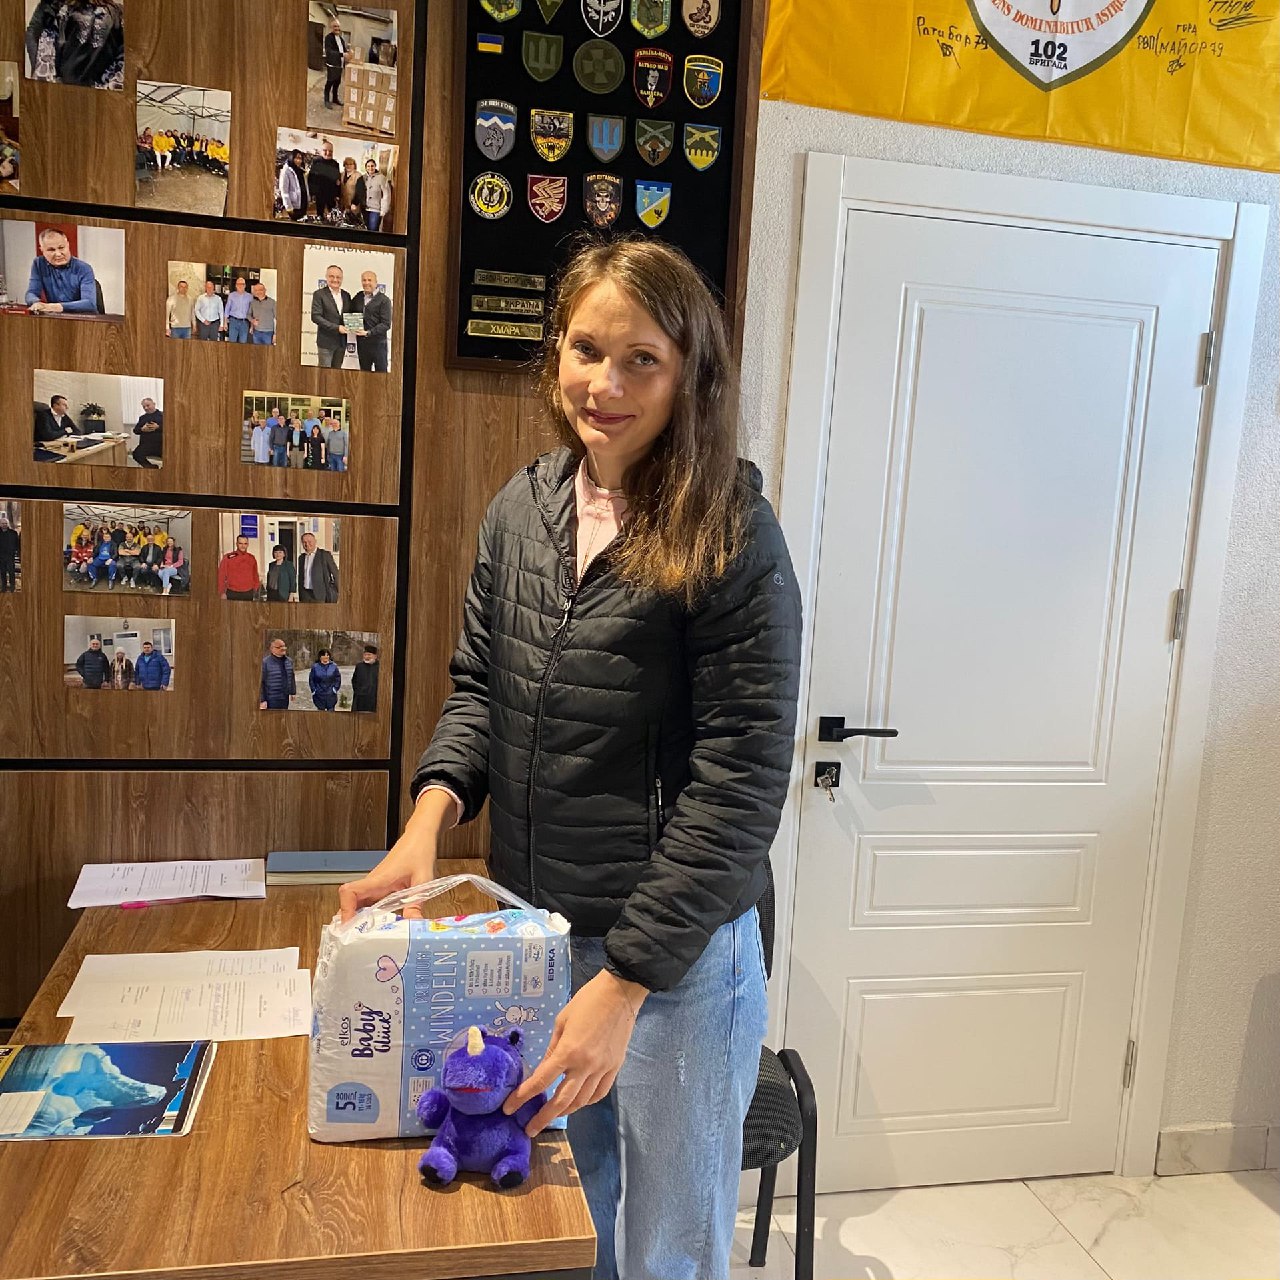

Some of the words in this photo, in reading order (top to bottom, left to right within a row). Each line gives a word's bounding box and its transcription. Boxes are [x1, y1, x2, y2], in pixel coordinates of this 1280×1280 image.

[1028, 57, 1068, 70] БРИГАДА
[1029, 39, 1068, 63] 102
[490, 324, 521, 335] ХМАРА
[414, 952, 432, 1004] PREMIUM
[547, 948, 556, 982] EDEKA
[429, 951, 458, 1044] WINDELN
[338, 1016, 351, 1046] elkos
[351, 1005, 384, 1058] Baby
[373, 1012, 392, 1053] Glück
[335, 1101, 356, 1111] 5
